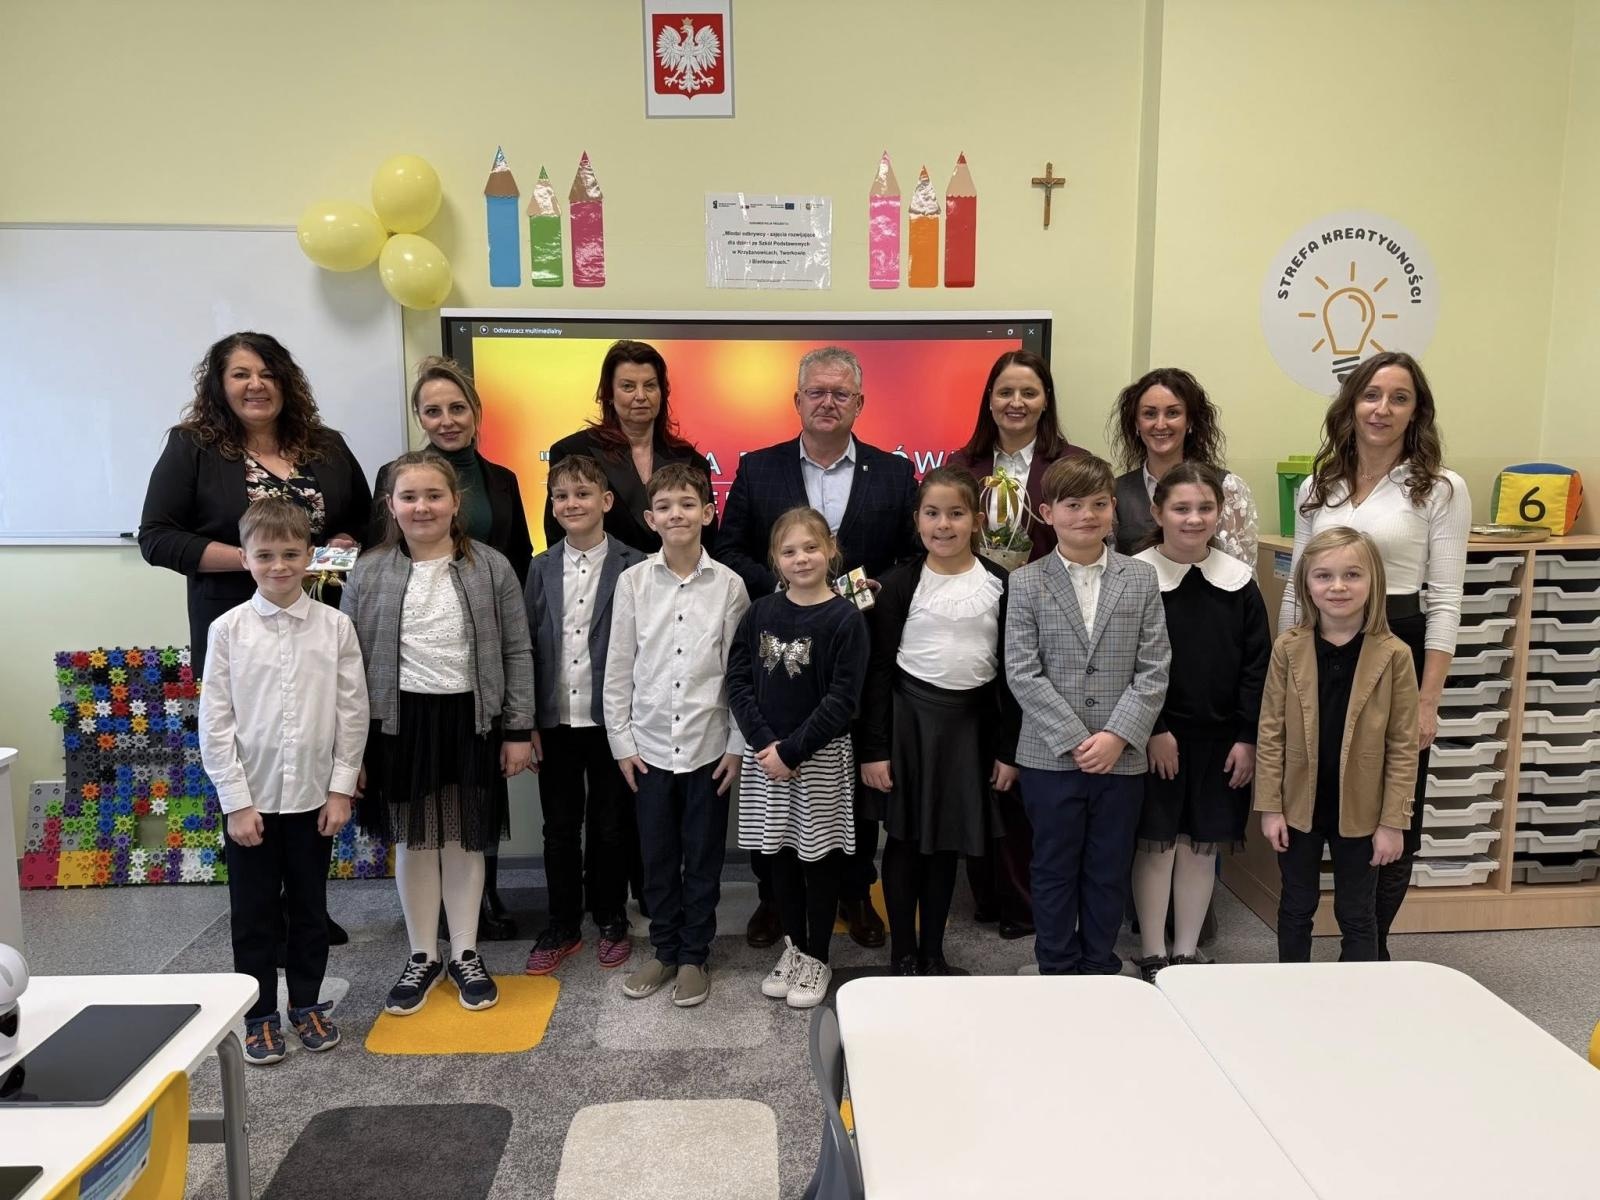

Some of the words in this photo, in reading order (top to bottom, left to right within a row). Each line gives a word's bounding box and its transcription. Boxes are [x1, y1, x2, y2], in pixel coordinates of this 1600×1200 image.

[1277, 240, 1320, 300] STREFA
[1321, 227, 1424, 304] KREATYWNOŚCI
[525, 328, 562, 336] multimedialny
[1519, 486, 1546, 523] 6
